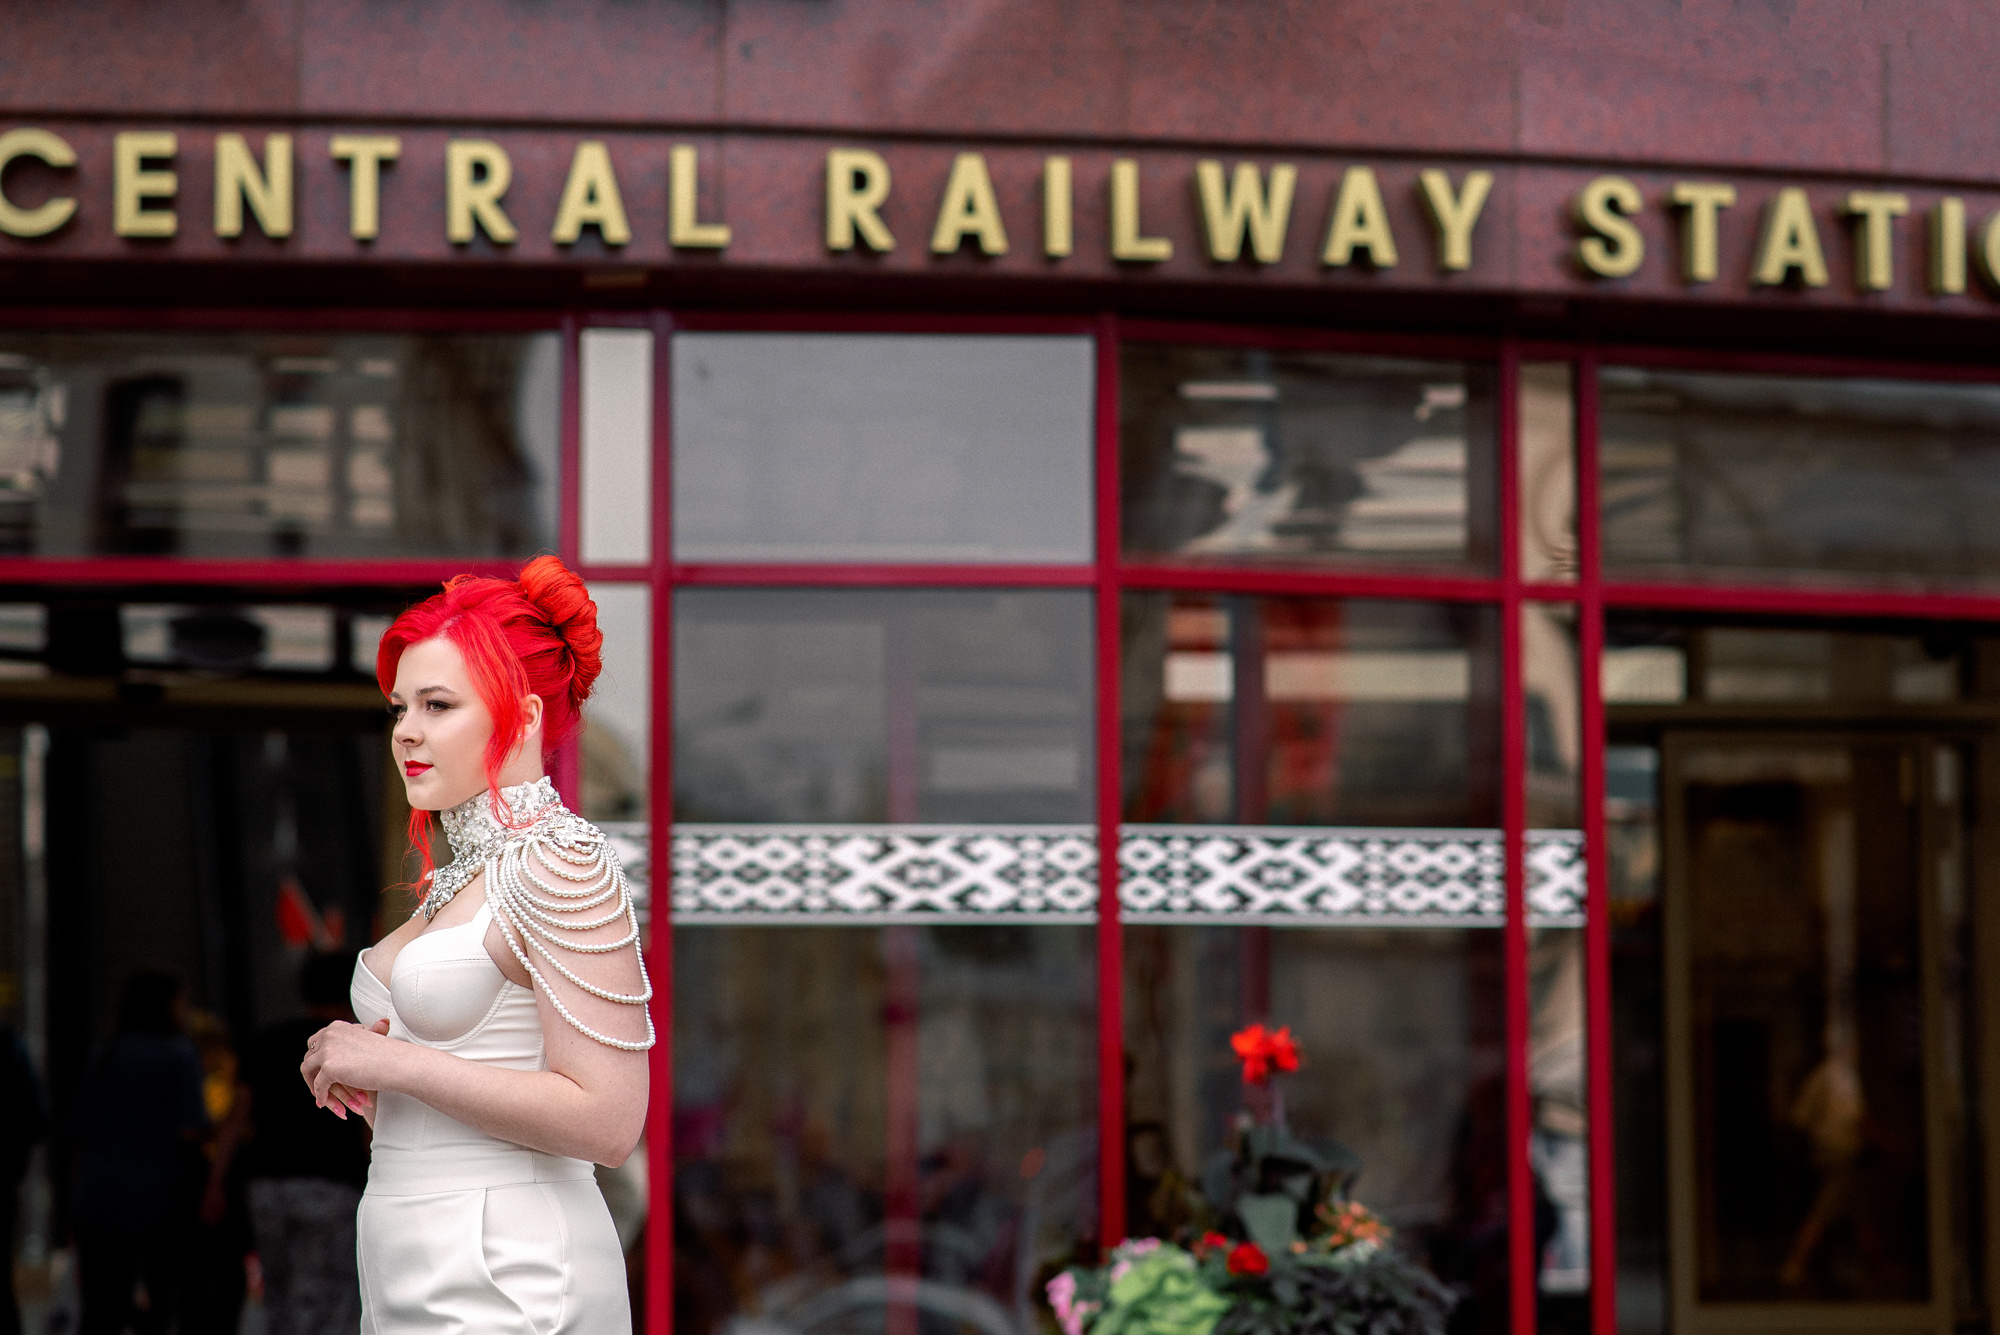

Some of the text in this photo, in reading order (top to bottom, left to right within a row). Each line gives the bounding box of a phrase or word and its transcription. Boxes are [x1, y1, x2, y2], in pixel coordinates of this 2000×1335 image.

[0, 127, 2000, 294] CENTRAL RAILWAY STATI
